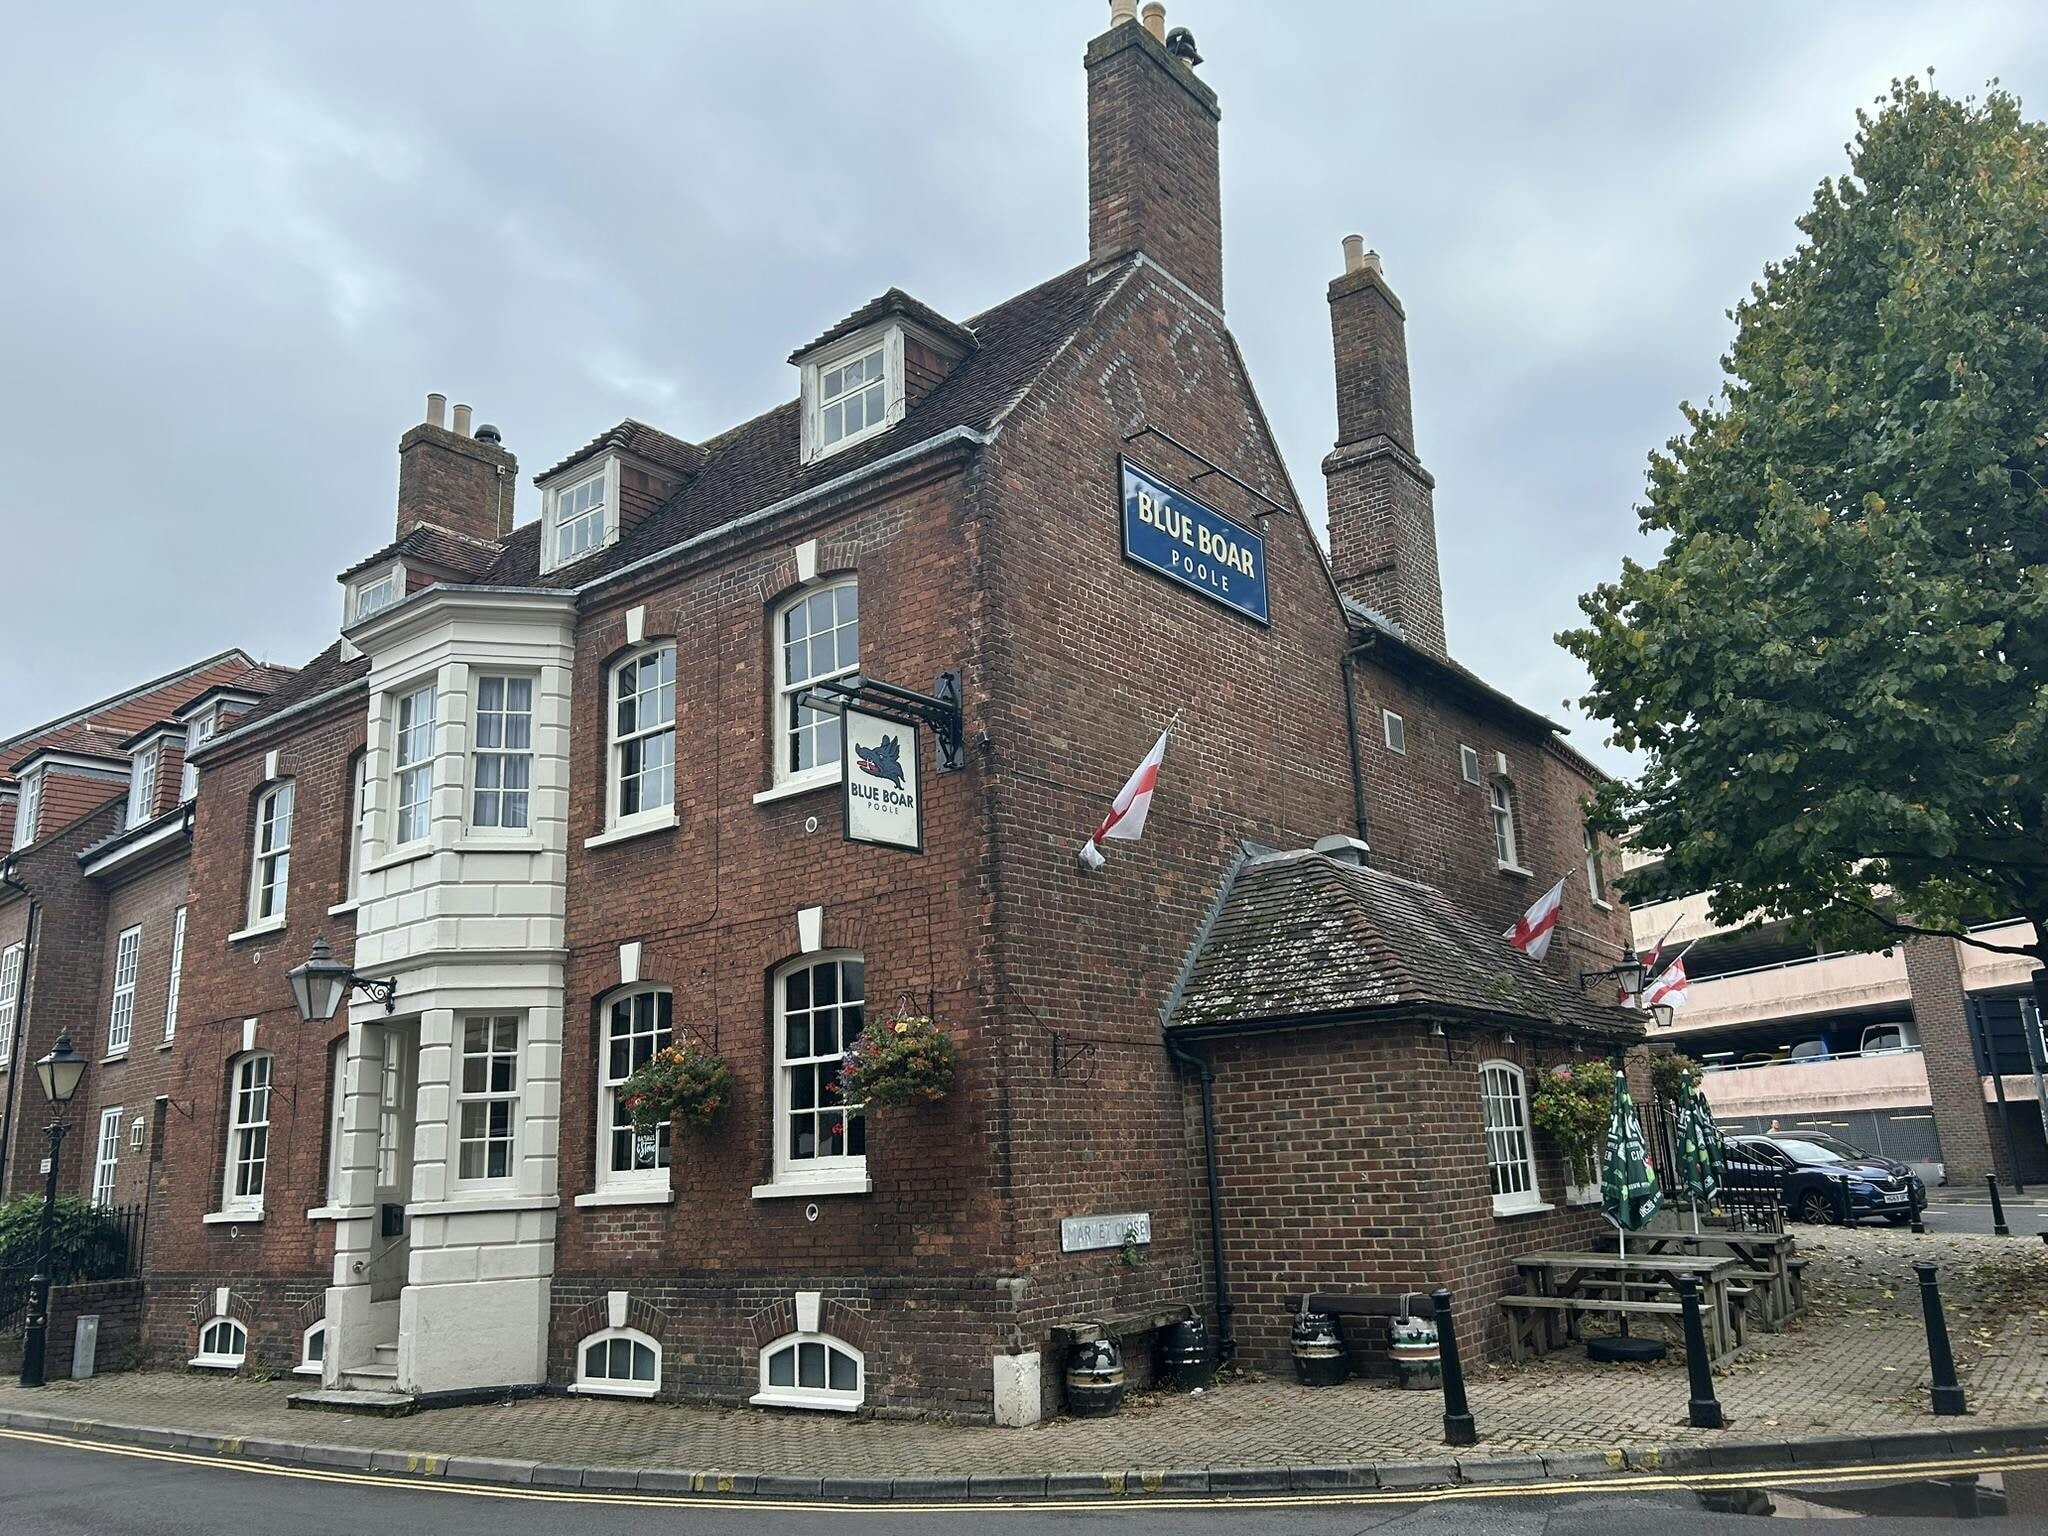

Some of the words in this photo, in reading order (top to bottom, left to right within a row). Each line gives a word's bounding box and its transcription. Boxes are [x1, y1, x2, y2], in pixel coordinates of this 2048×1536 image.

[1137, 491, 1195, 548] BLUE
[1198, 524, 1255, 579] BOAR
[1171, 549, 1229, 592] POOLE
[851, 782, 879, 801] BLUE
[882, 791, 914, 809] BOAR
[867, 801, 899, 815] POOLE
